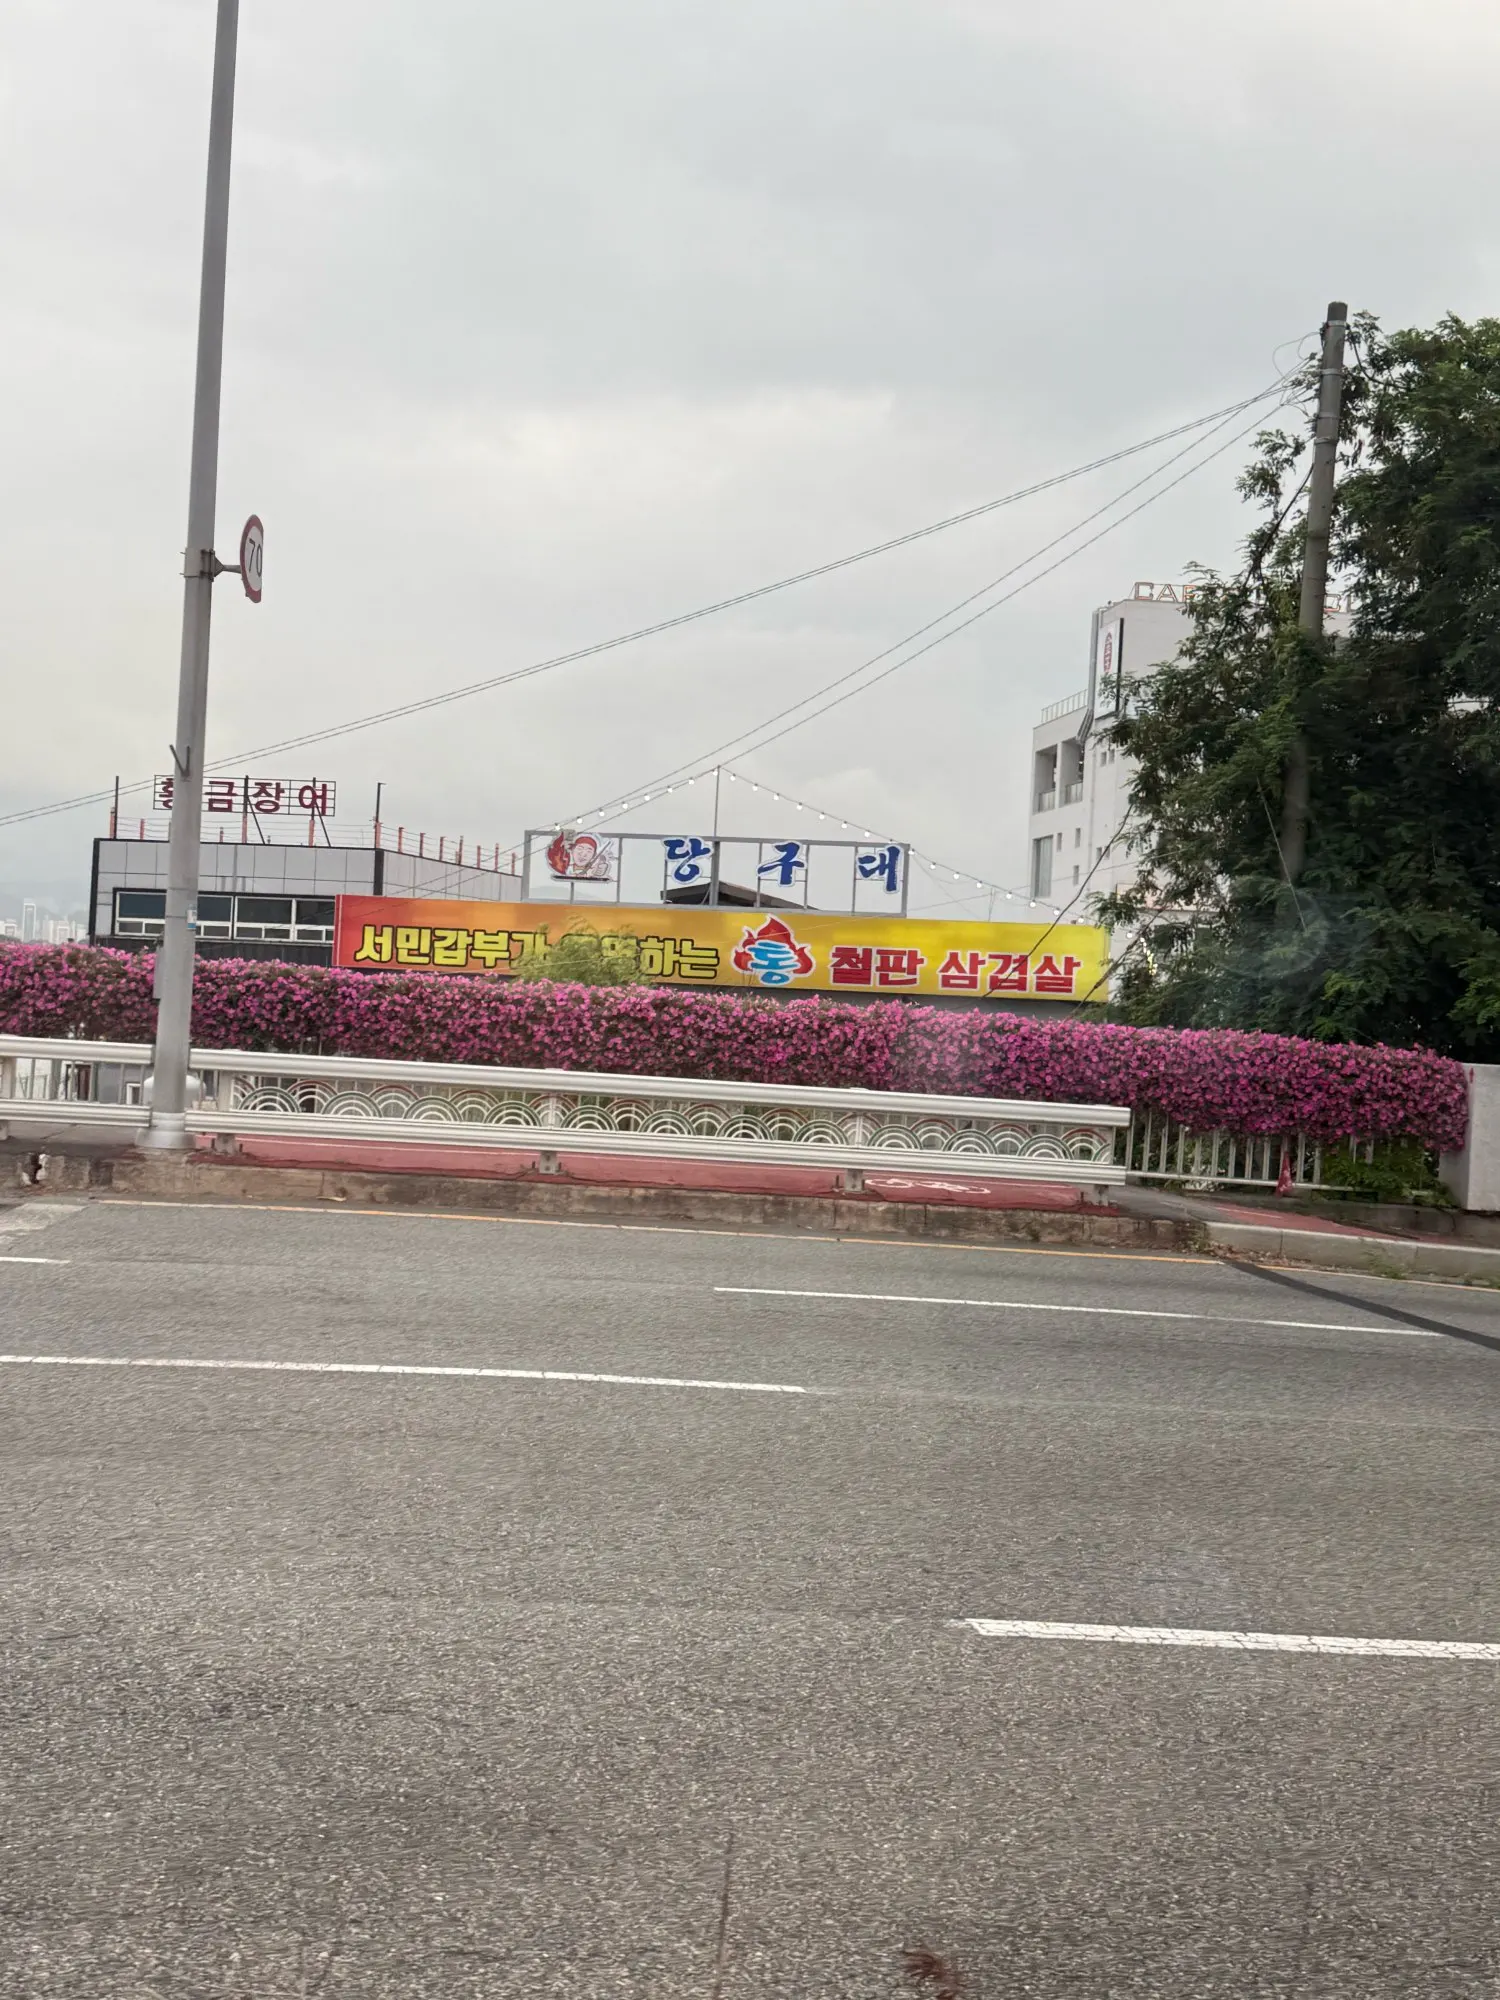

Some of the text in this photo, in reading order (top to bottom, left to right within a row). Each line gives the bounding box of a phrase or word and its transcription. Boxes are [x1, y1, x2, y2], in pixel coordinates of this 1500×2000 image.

[249, 538, 262, 577] 70
[354, 925, 552, 969] 서민갑부가
[560, 934, 720, 979] 영하는
[831, 946, 926, 987] 철판
[938, 951, 1082, 994] 삼겹살
